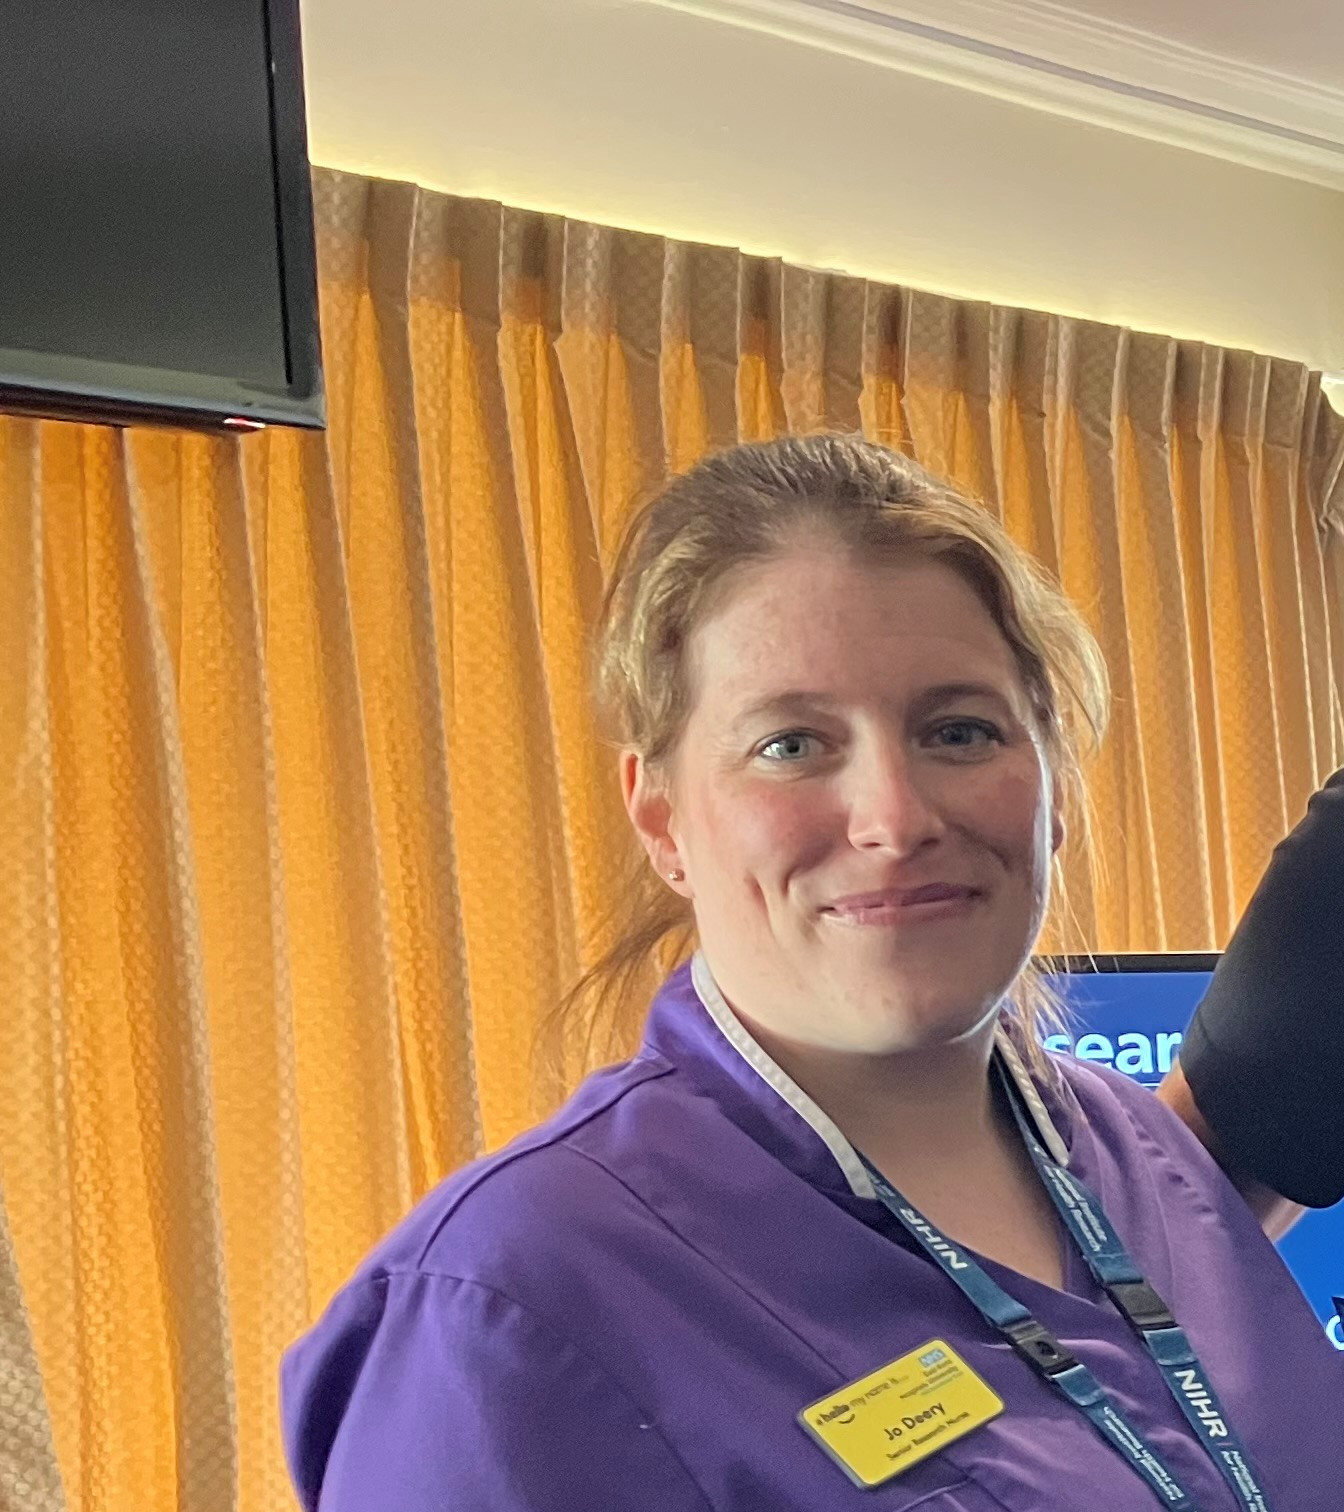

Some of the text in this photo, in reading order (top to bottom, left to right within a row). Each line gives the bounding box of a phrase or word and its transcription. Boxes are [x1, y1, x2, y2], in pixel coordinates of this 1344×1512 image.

[900, 1207, 968, 1270] NIHR
[884, 1402, 946, 1441] Jo Deery
[1174, 1369, 1228, 1437] NIHR
